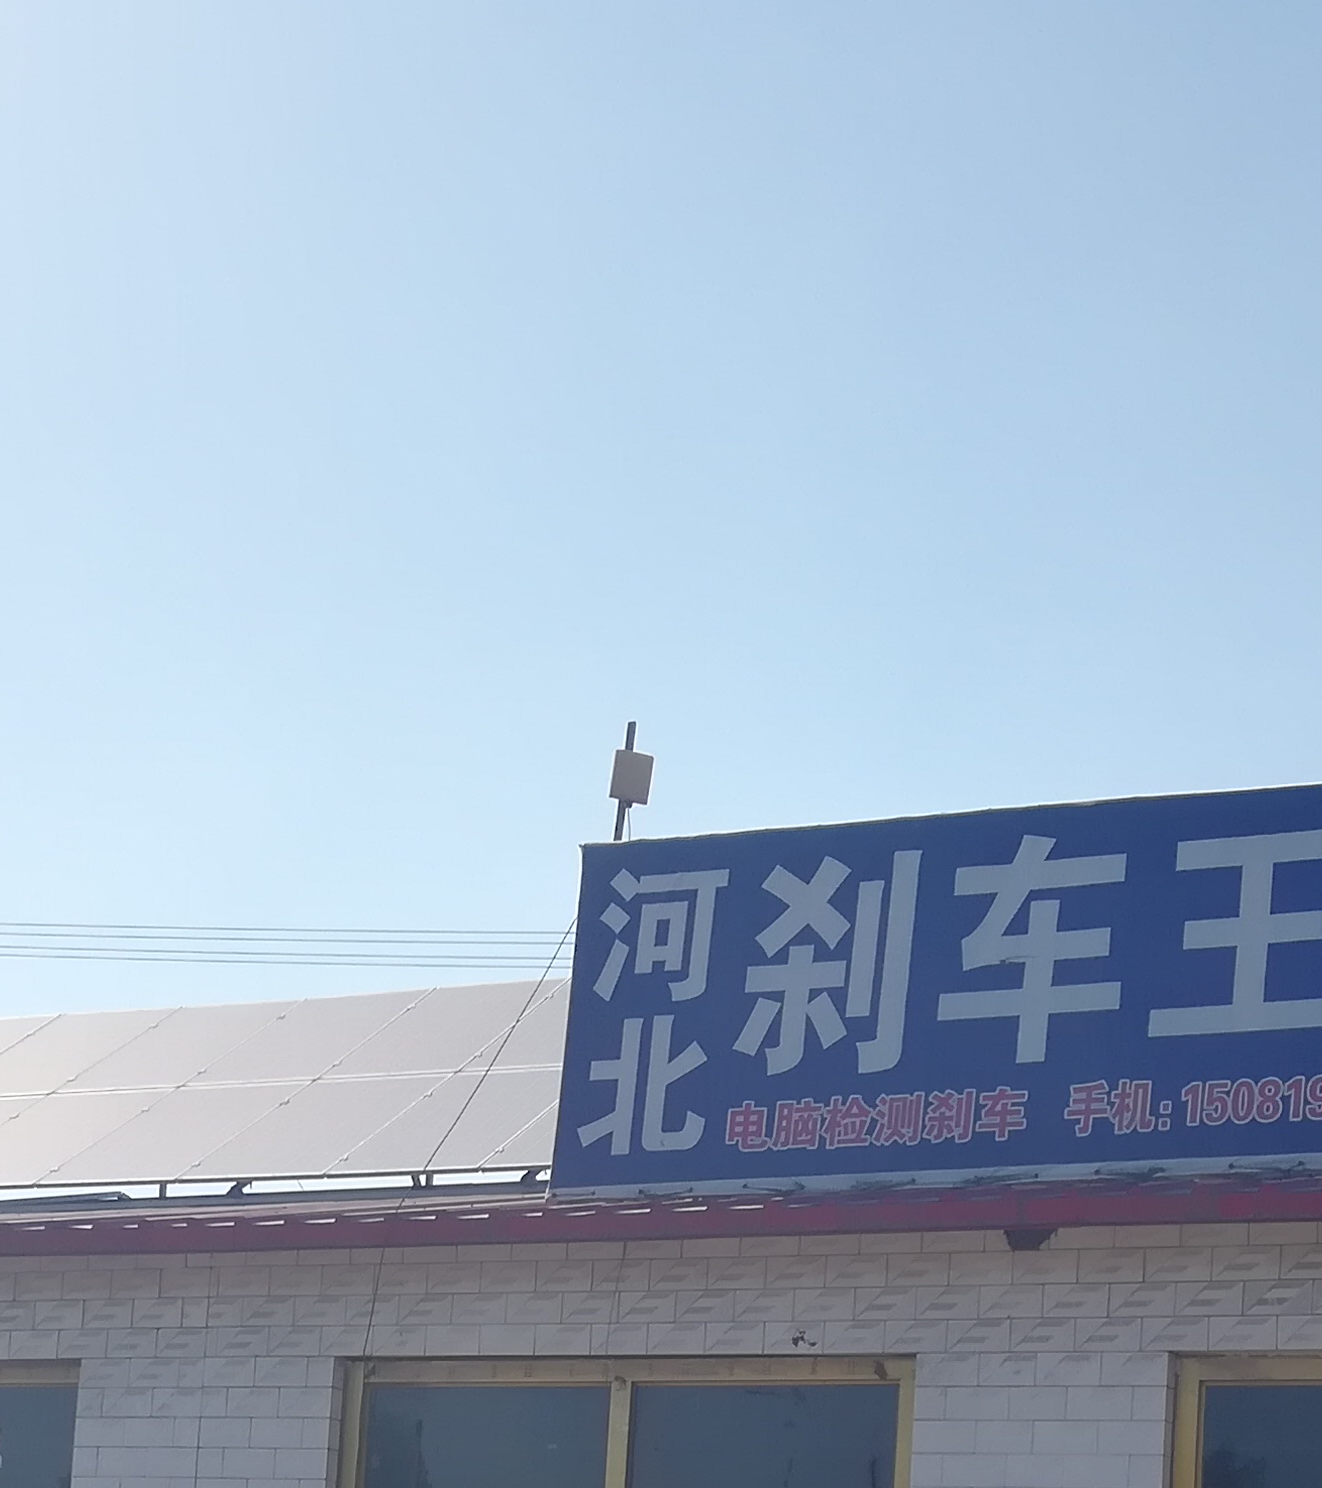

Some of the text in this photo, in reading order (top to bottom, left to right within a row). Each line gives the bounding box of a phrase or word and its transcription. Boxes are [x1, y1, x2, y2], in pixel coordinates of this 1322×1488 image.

[576, 868, 728, 1155] 河北
[724, 1088, 1027, 1154] 电脑检测刹车
